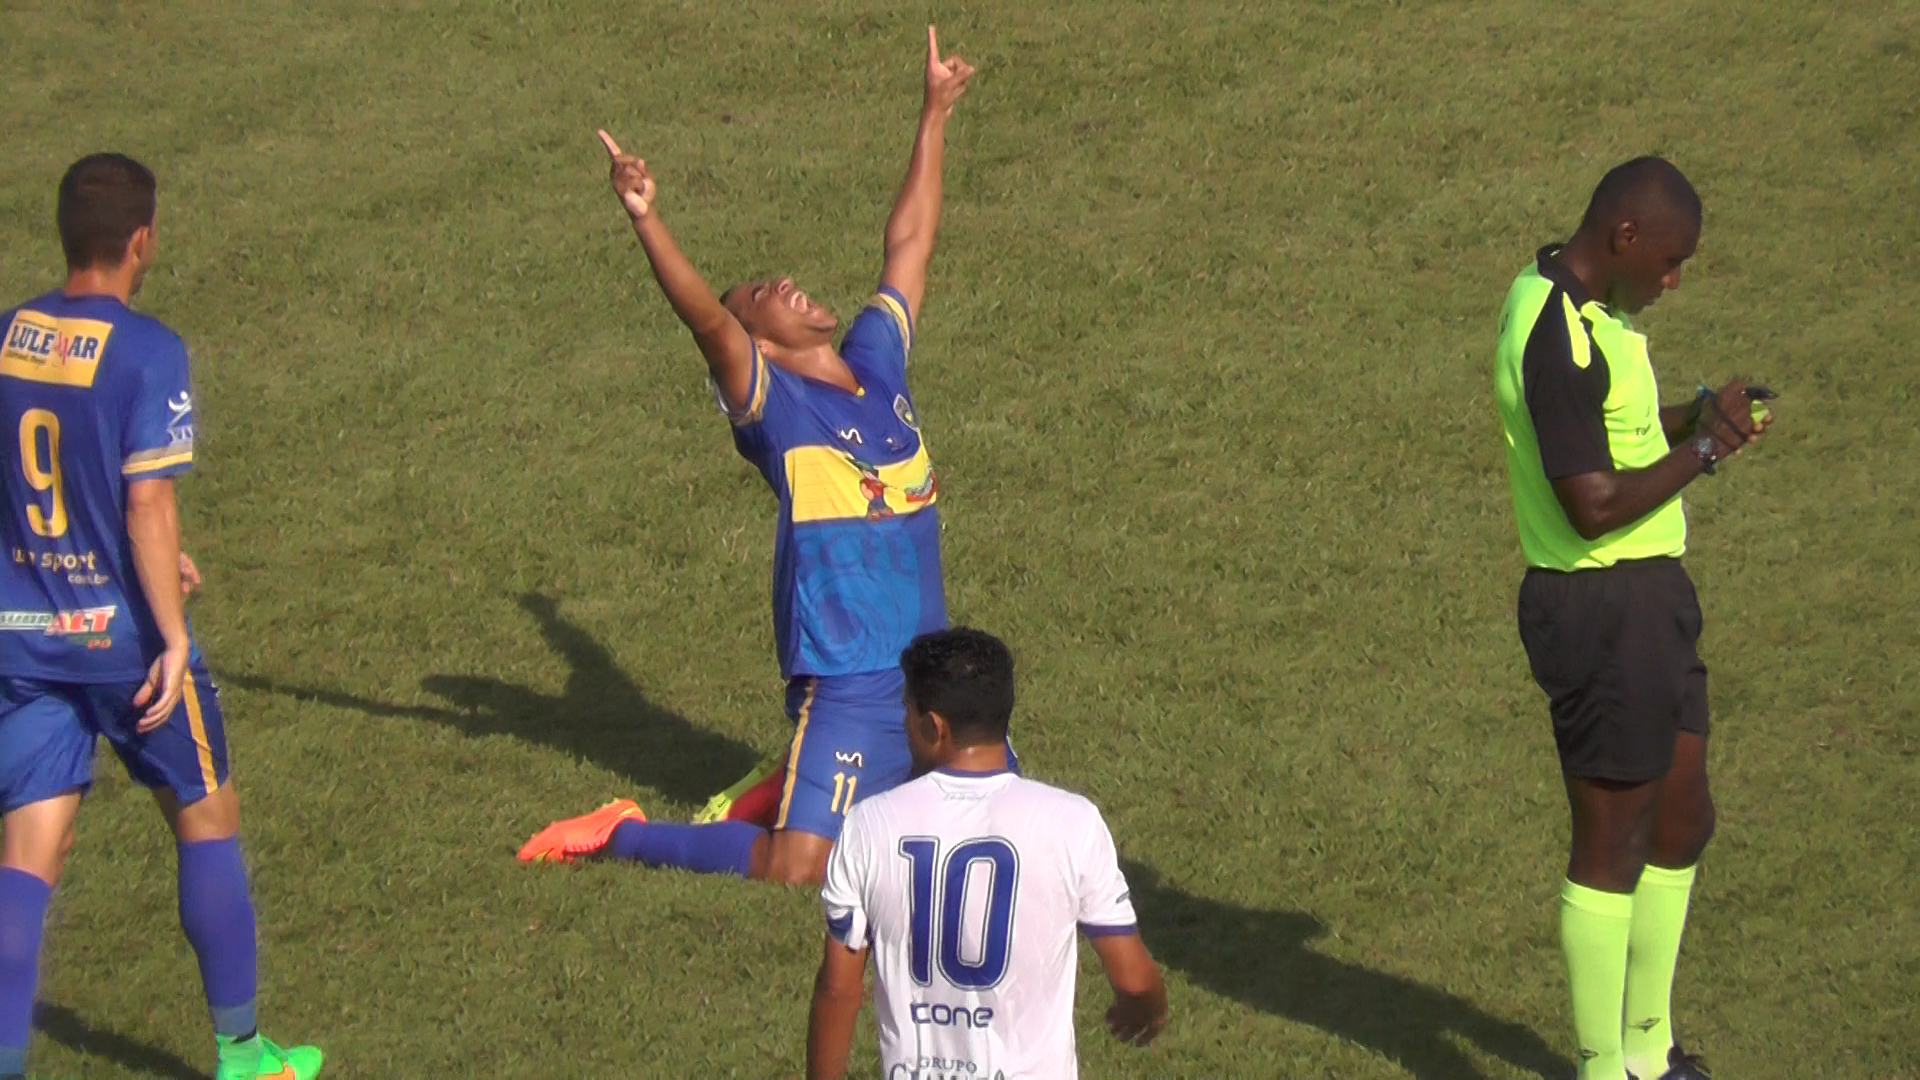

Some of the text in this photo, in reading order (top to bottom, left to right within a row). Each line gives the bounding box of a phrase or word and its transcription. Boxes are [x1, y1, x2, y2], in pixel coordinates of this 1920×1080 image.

[18, 407, 69, 538] 9
[38, 549, 97, 572] sport
[830, 771, 858, 817] 11
[898, 835, 1020, 992] 10
[918, 1054, 979, 1074] GRUPO
